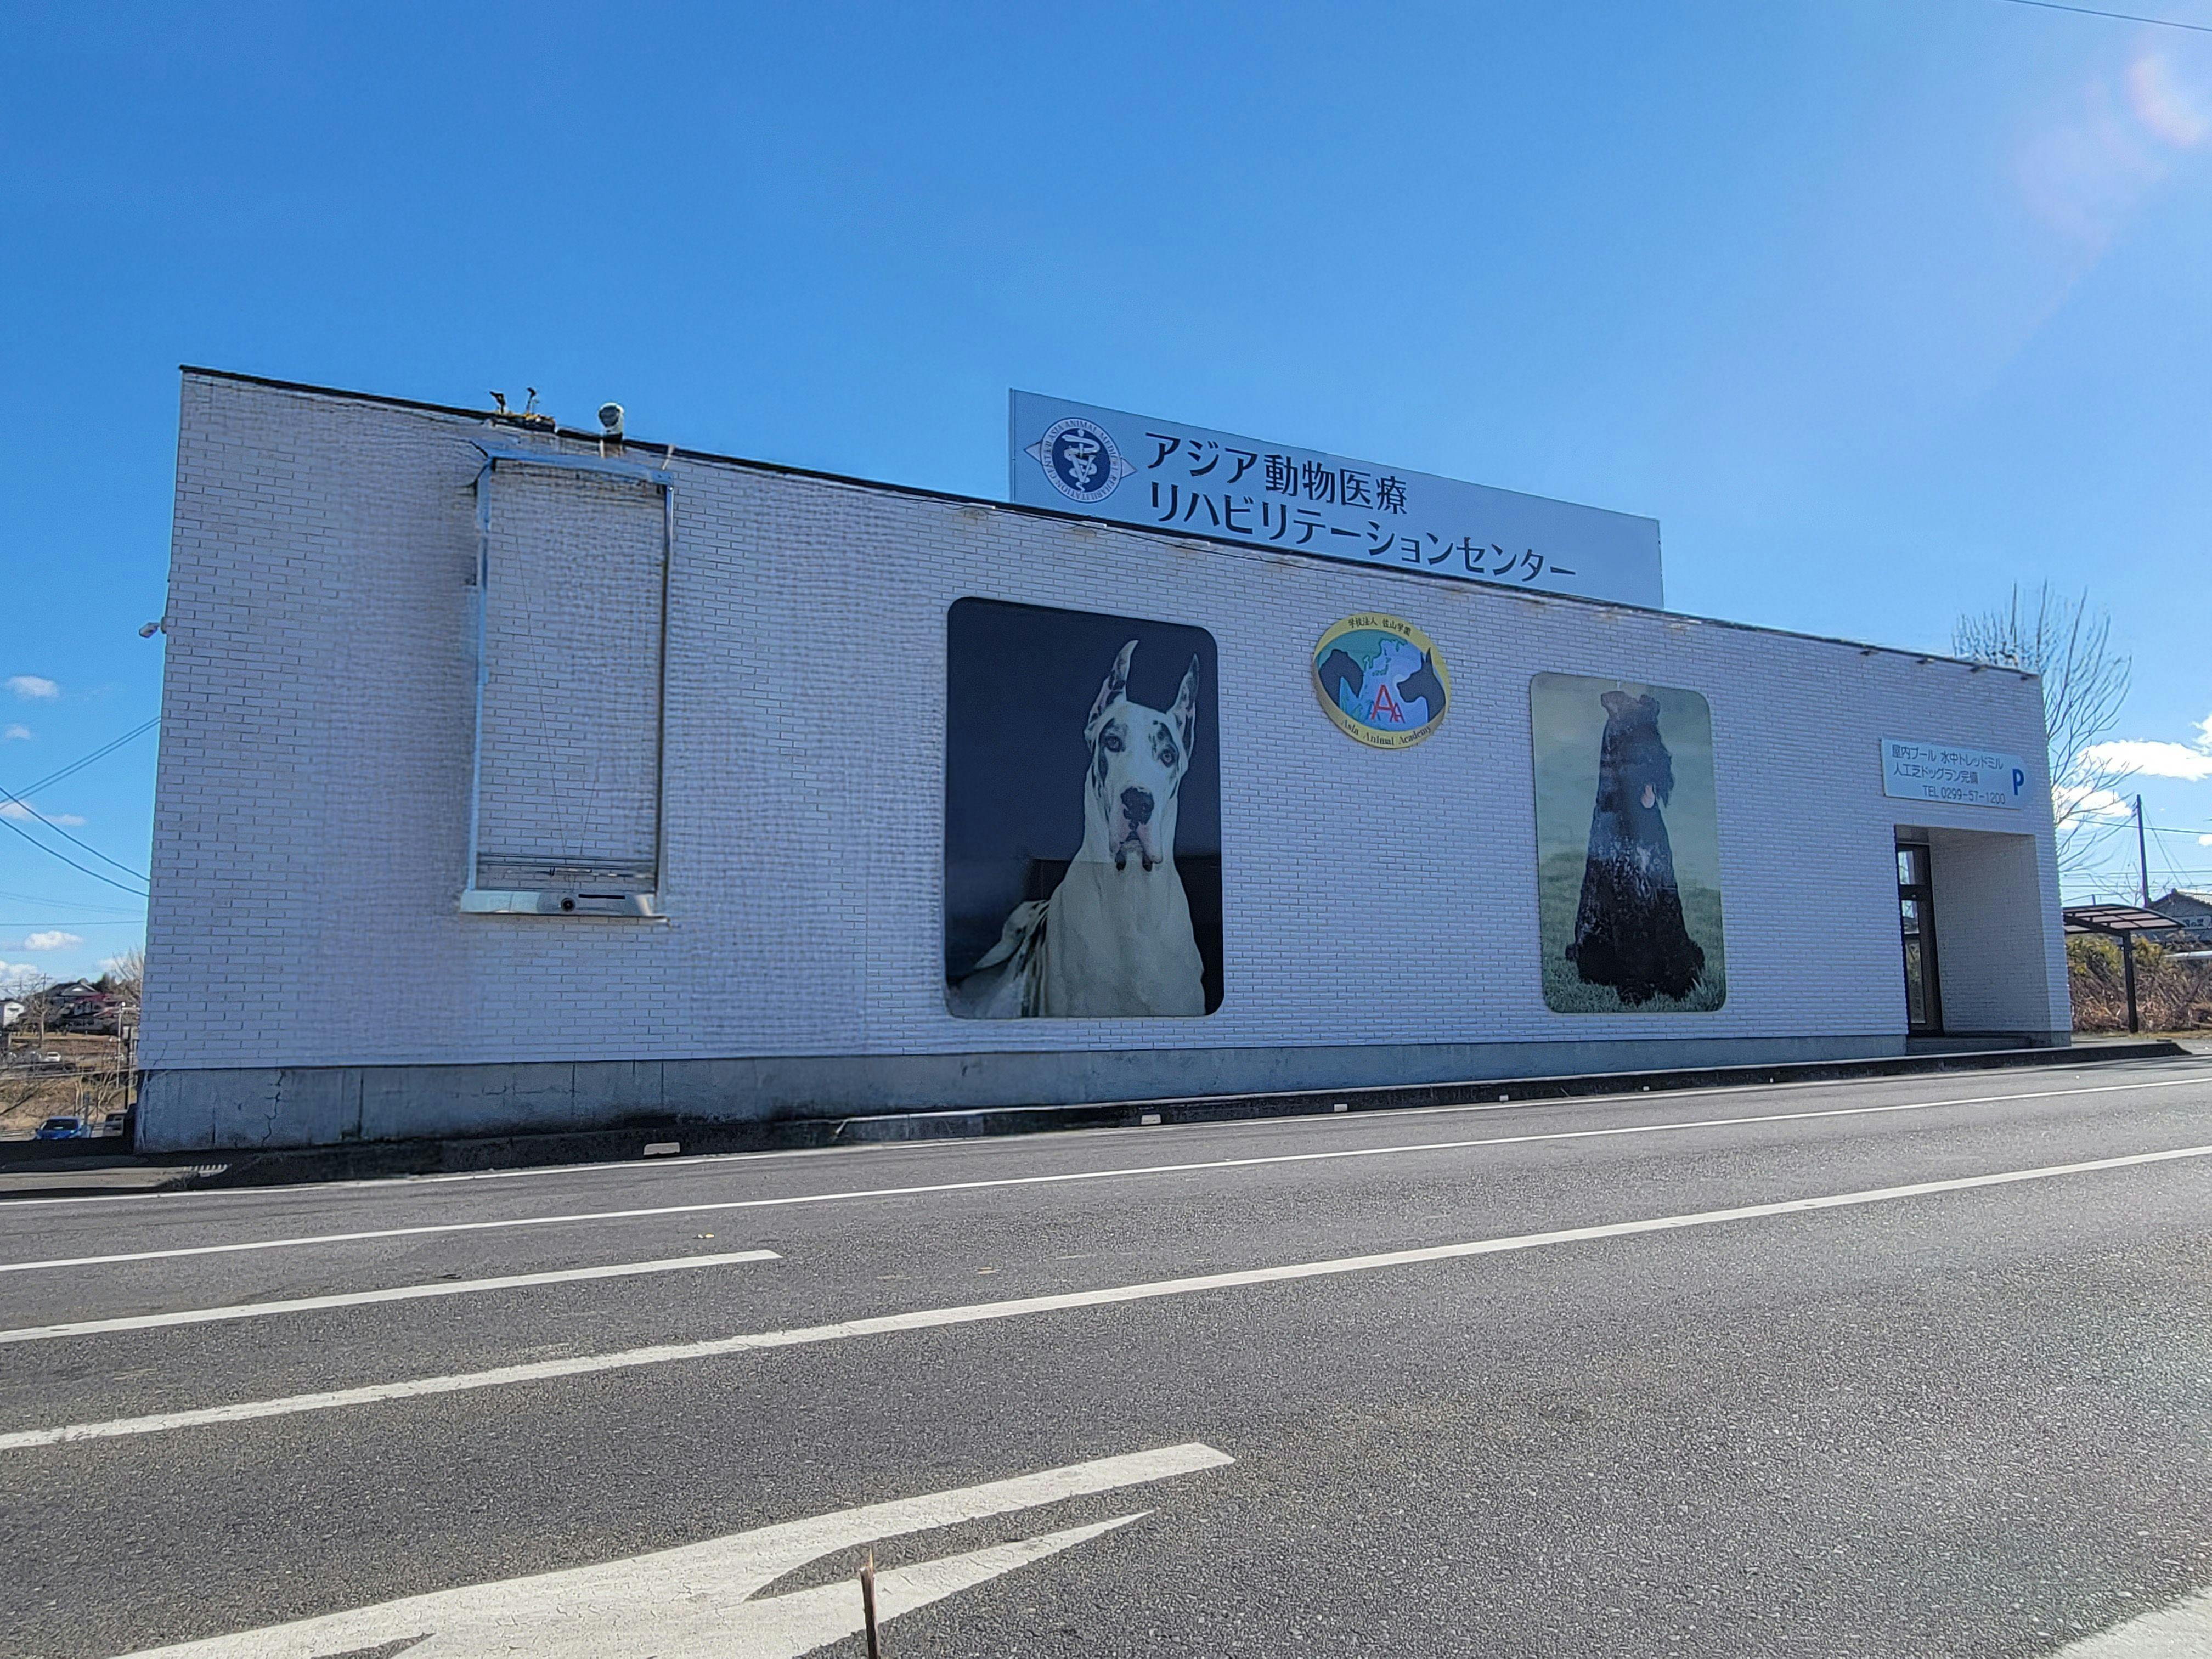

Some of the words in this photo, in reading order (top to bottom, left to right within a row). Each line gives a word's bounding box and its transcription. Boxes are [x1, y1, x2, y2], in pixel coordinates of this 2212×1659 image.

[1051, 424, 1064, 439] ASIA
[1065, 420, 1097, 434] ANIMAL
[1099, 432, 1119, 470] MEDICL
[1146, 432, 1408, 515] アジア動物医療
[1151, 481, 1576, 582] リハビリテーションセンター
[1348, 617, 1378, 628] 学校法人
[1342, 720, 1359, 736] Asia
[1363, 732, 1394, 746] Animal
[1398, 725, 1431, 745] Academy
[1892, 745, 1937, 762] 屋内プール
[1940, 751, 2004, 770] 水中トレッドミル
[1922, 785, 1939, 798] TEL
[1941, 787, 2005, 804] 0299-57-1200
[2012, 769, 2024, 796] P
